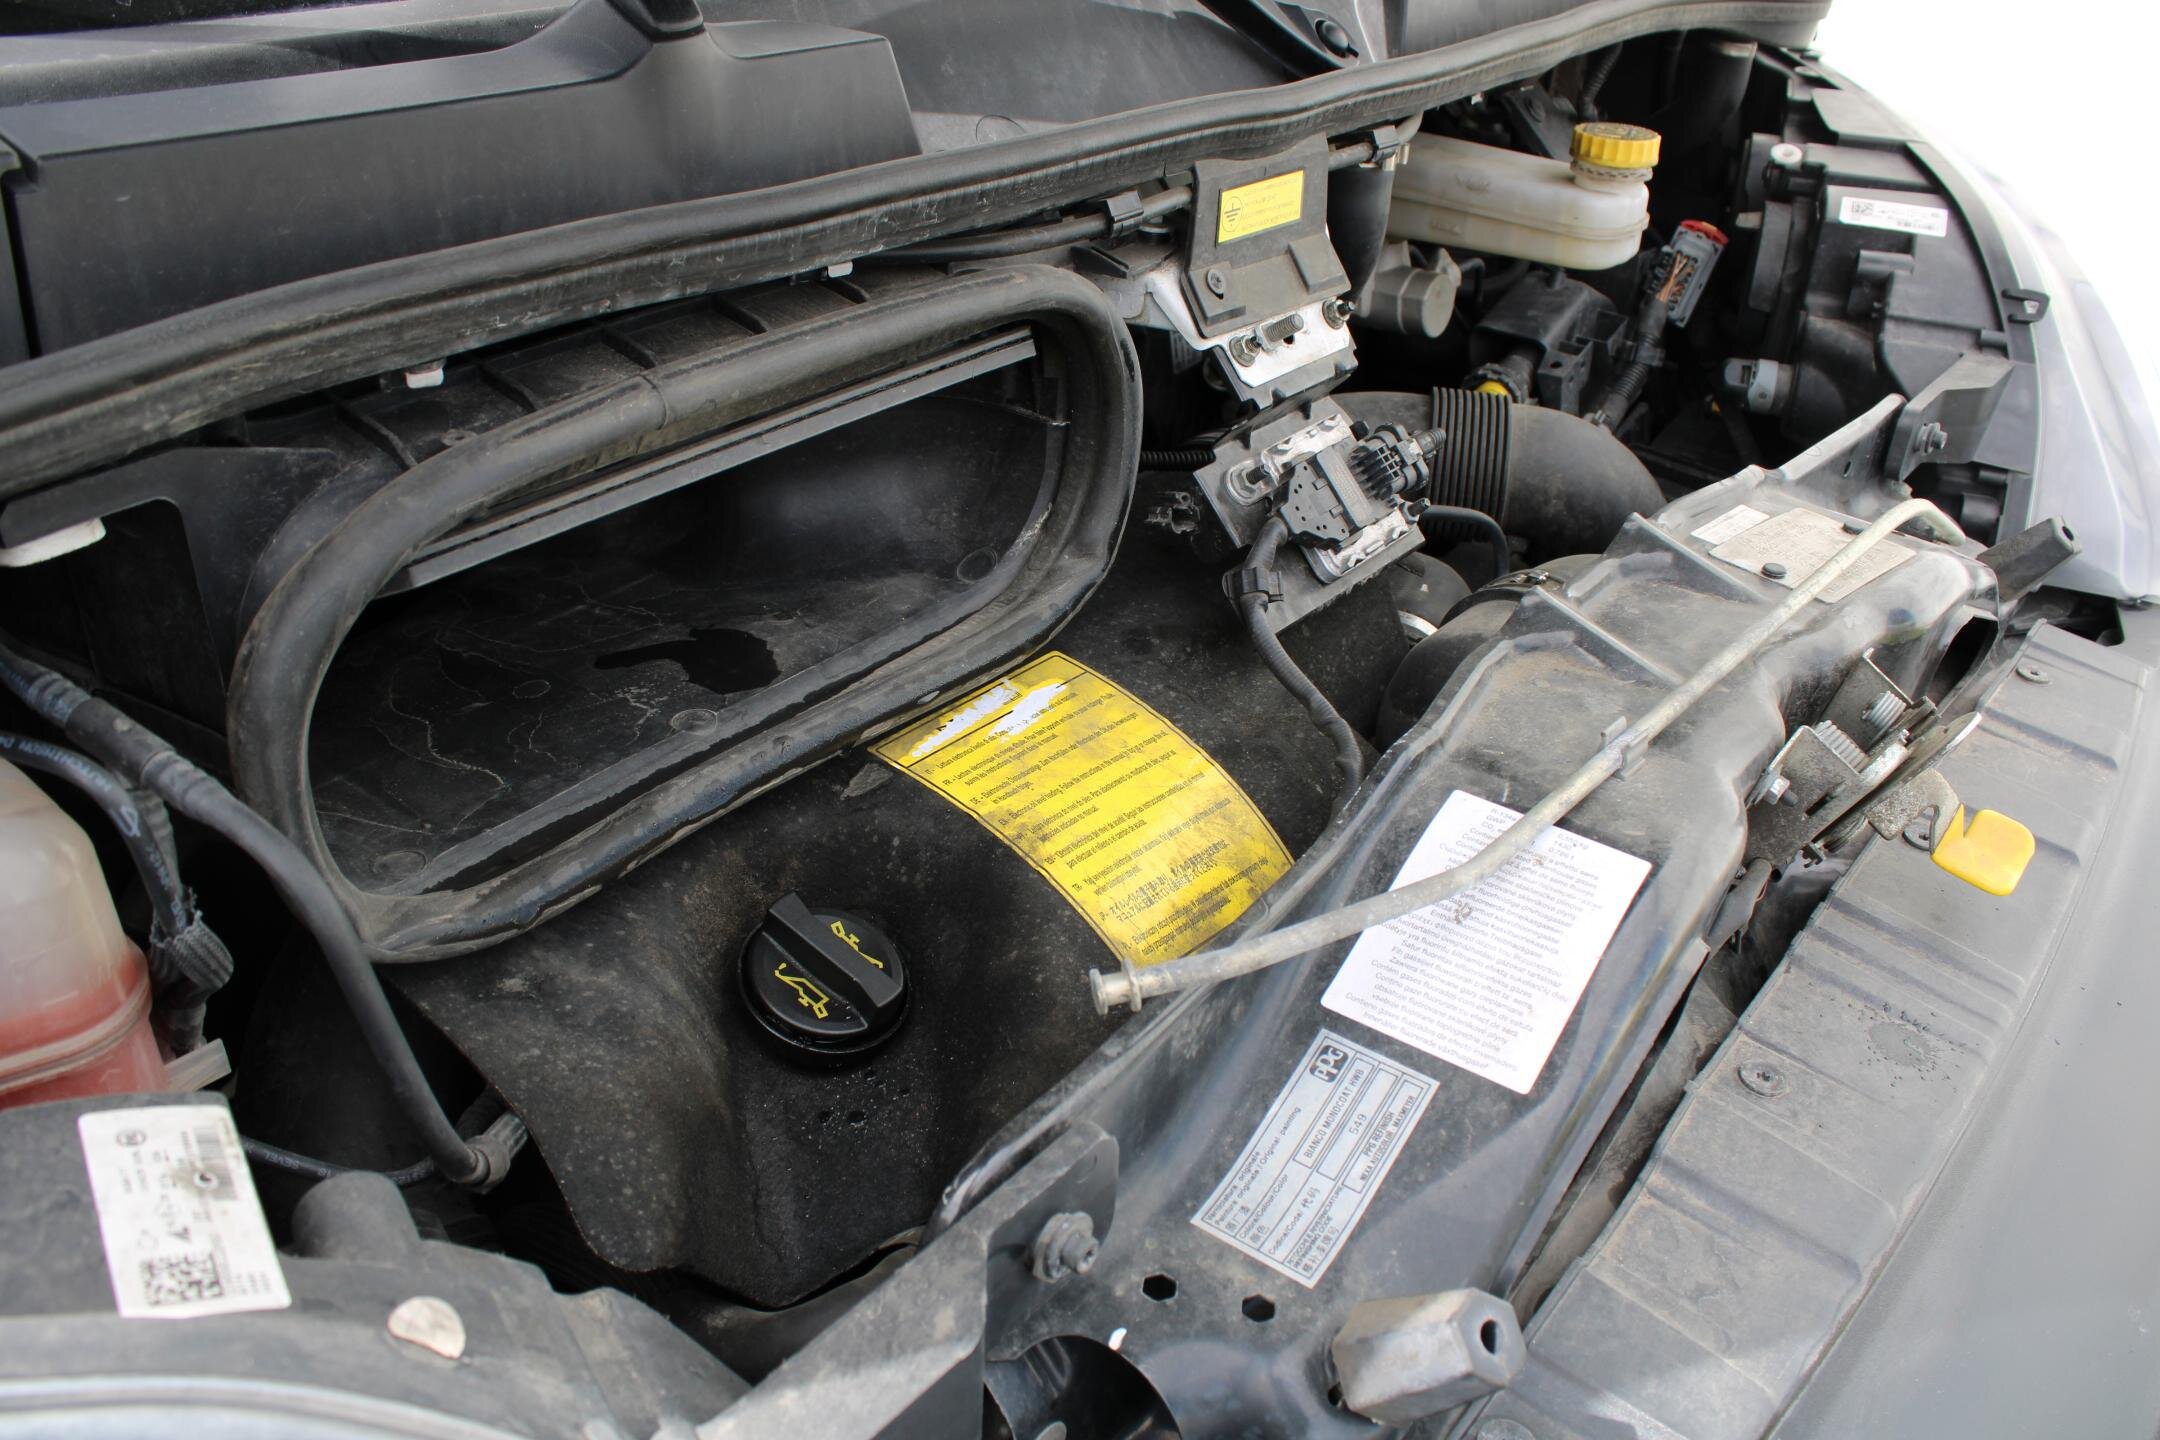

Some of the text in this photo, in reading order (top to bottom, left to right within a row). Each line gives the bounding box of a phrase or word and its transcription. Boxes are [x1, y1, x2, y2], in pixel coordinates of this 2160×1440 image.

[19, 741, 111, 791] HUTCHINSON
[1314, 1046, 1344, 1080] PPG
[1301, 1068, 1365, 1158] BIANCO MONOCOAT HWB
[1347, 1112, 1368, 1135] 549
[1361, 1110, 1395, 1156] PPG REFINISH
[265, 1151, 299, 1168] SEVEL
[1214, 1199, 1237, 1226] Peinture
[1258, 1137, 1282, 1165] Original
[1278, 1106, 1301, 1134] painting
[1236, 1151, 1261, 1181] originale
[1318, 1215, 1332, 1232] CODE
